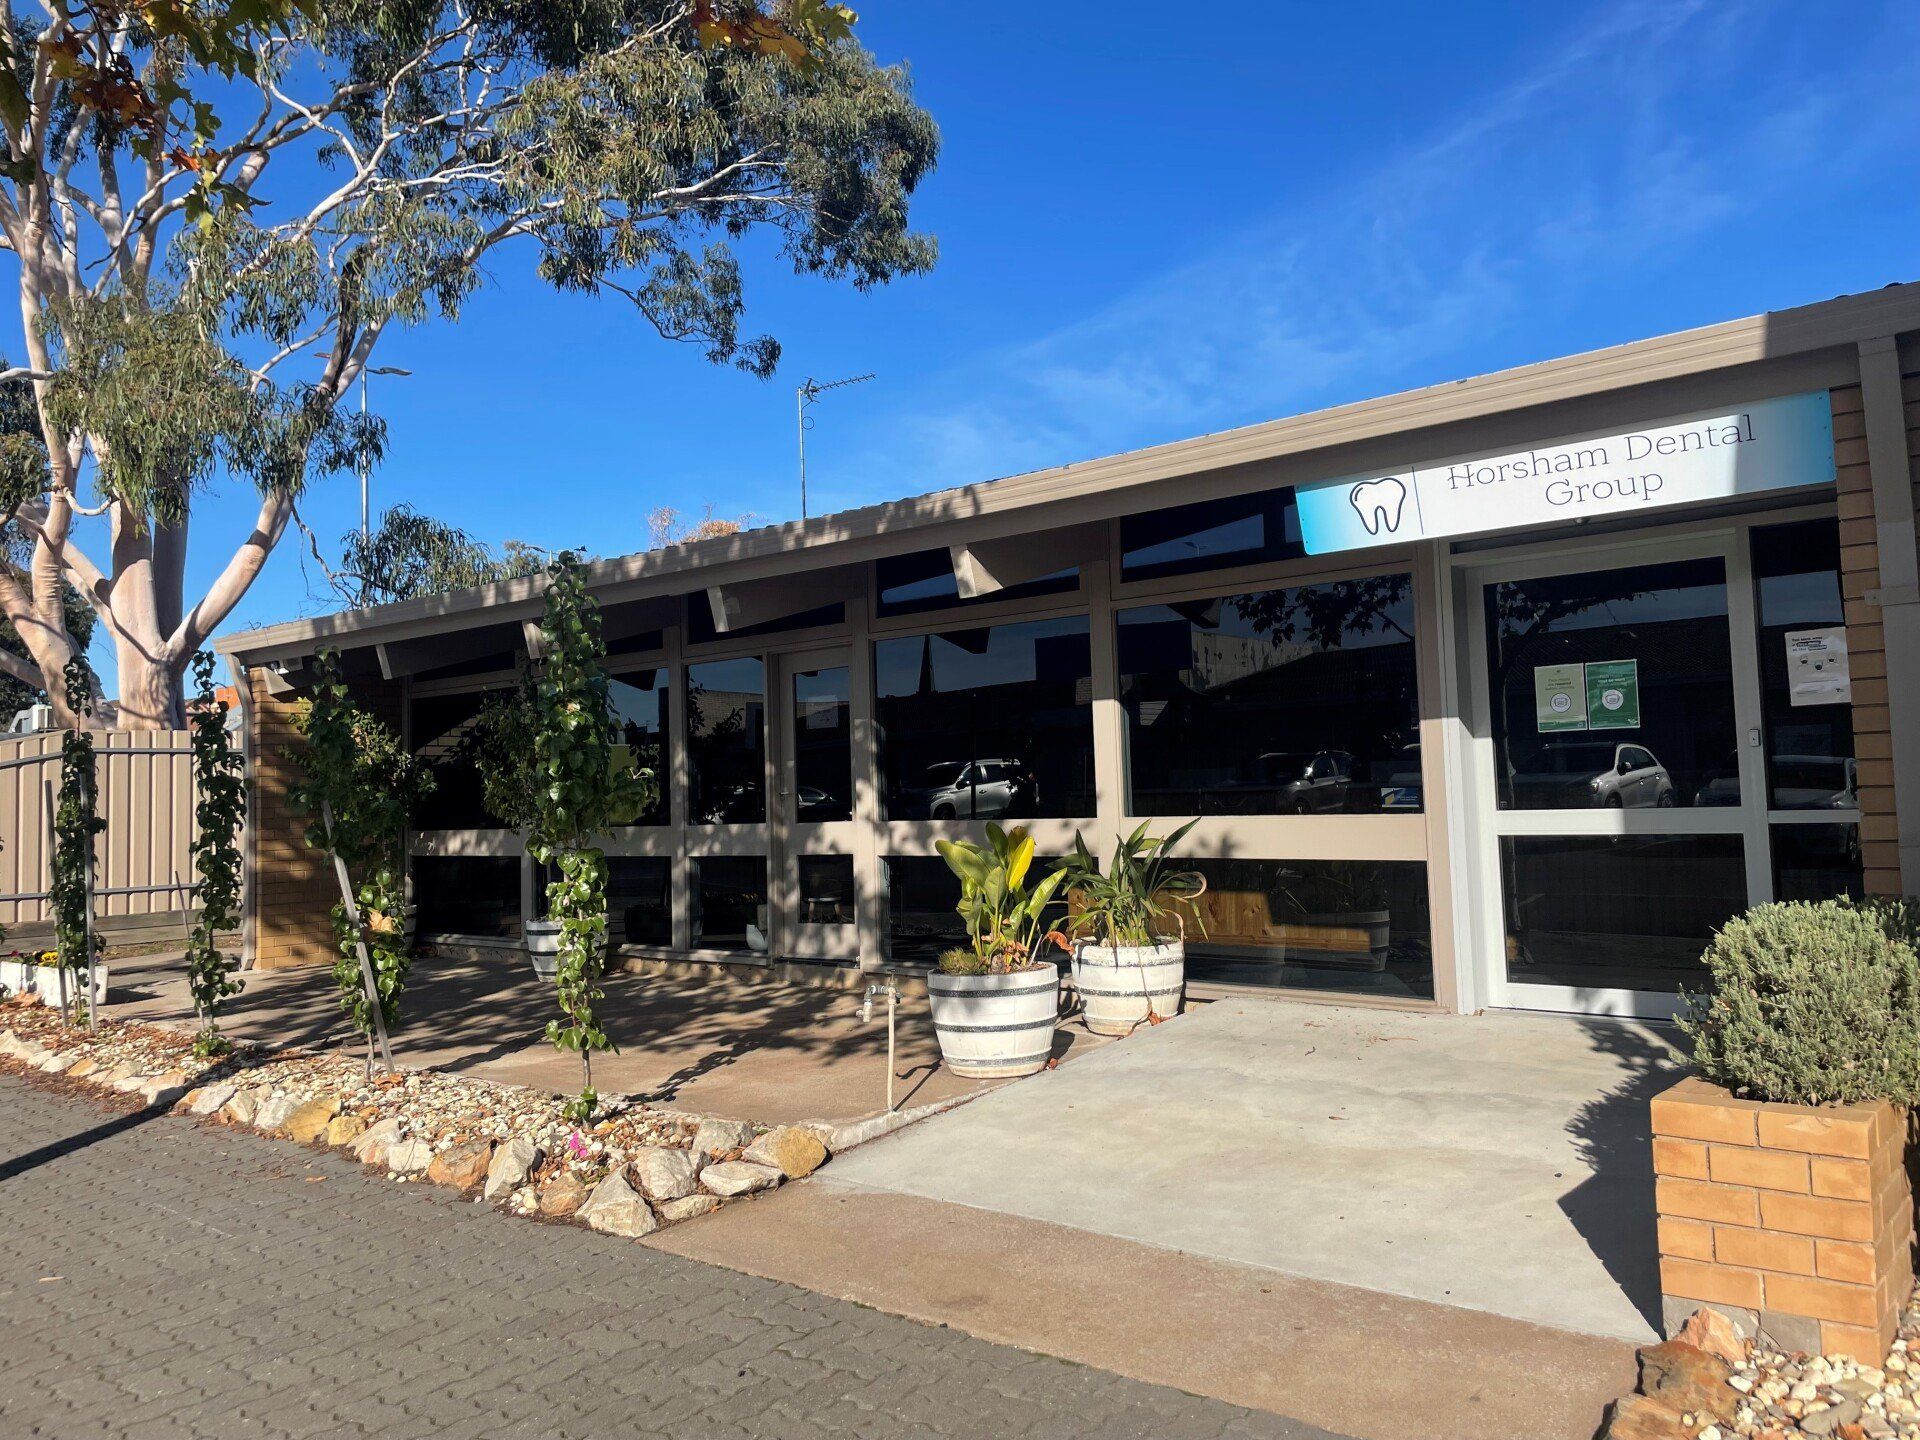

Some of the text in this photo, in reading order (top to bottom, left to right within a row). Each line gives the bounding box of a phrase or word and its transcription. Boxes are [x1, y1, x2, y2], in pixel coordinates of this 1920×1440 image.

[1447, 414, 1757, 490] Horsham Dental
[1545, 472, 1664, 506] Group
